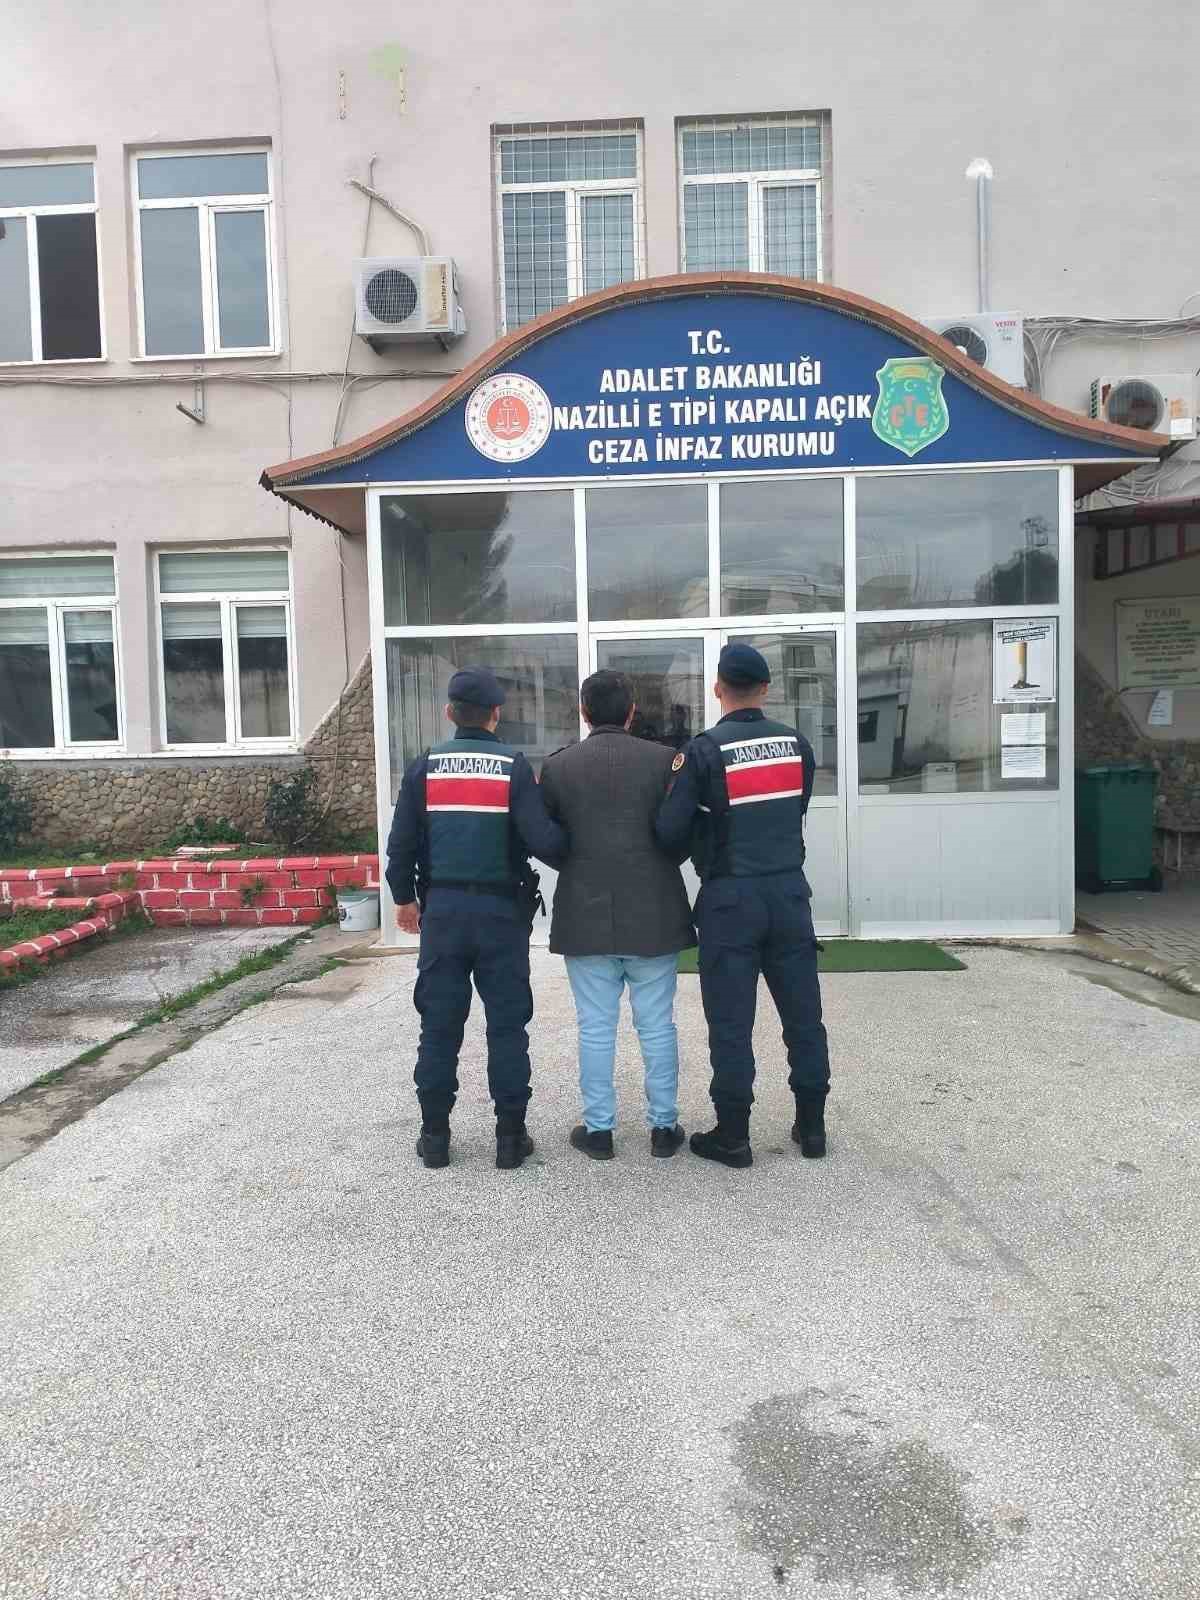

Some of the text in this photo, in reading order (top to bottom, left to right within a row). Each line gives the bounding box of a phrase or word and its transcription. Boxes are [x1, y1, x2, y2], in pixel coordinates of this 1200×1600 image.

[687, 329, 732, 355] T.C.
[599, 355, 822, 394] ADALET BAKANLIĞI
[553, 398, 641, 431] NAZİLLİ
[648, 403, 662, 427] E
[669, 395, 716, 426] TİPİ
[724, 397, 808, 425] KAPALI
[814, 395, 872, 426] AÇIK
[588, 431, 836, 464] CEZA İNFAZ KURUMU
[434, 758, 503, 775] JANDARMA
[732, 742, 796, 763] JANDARMA
